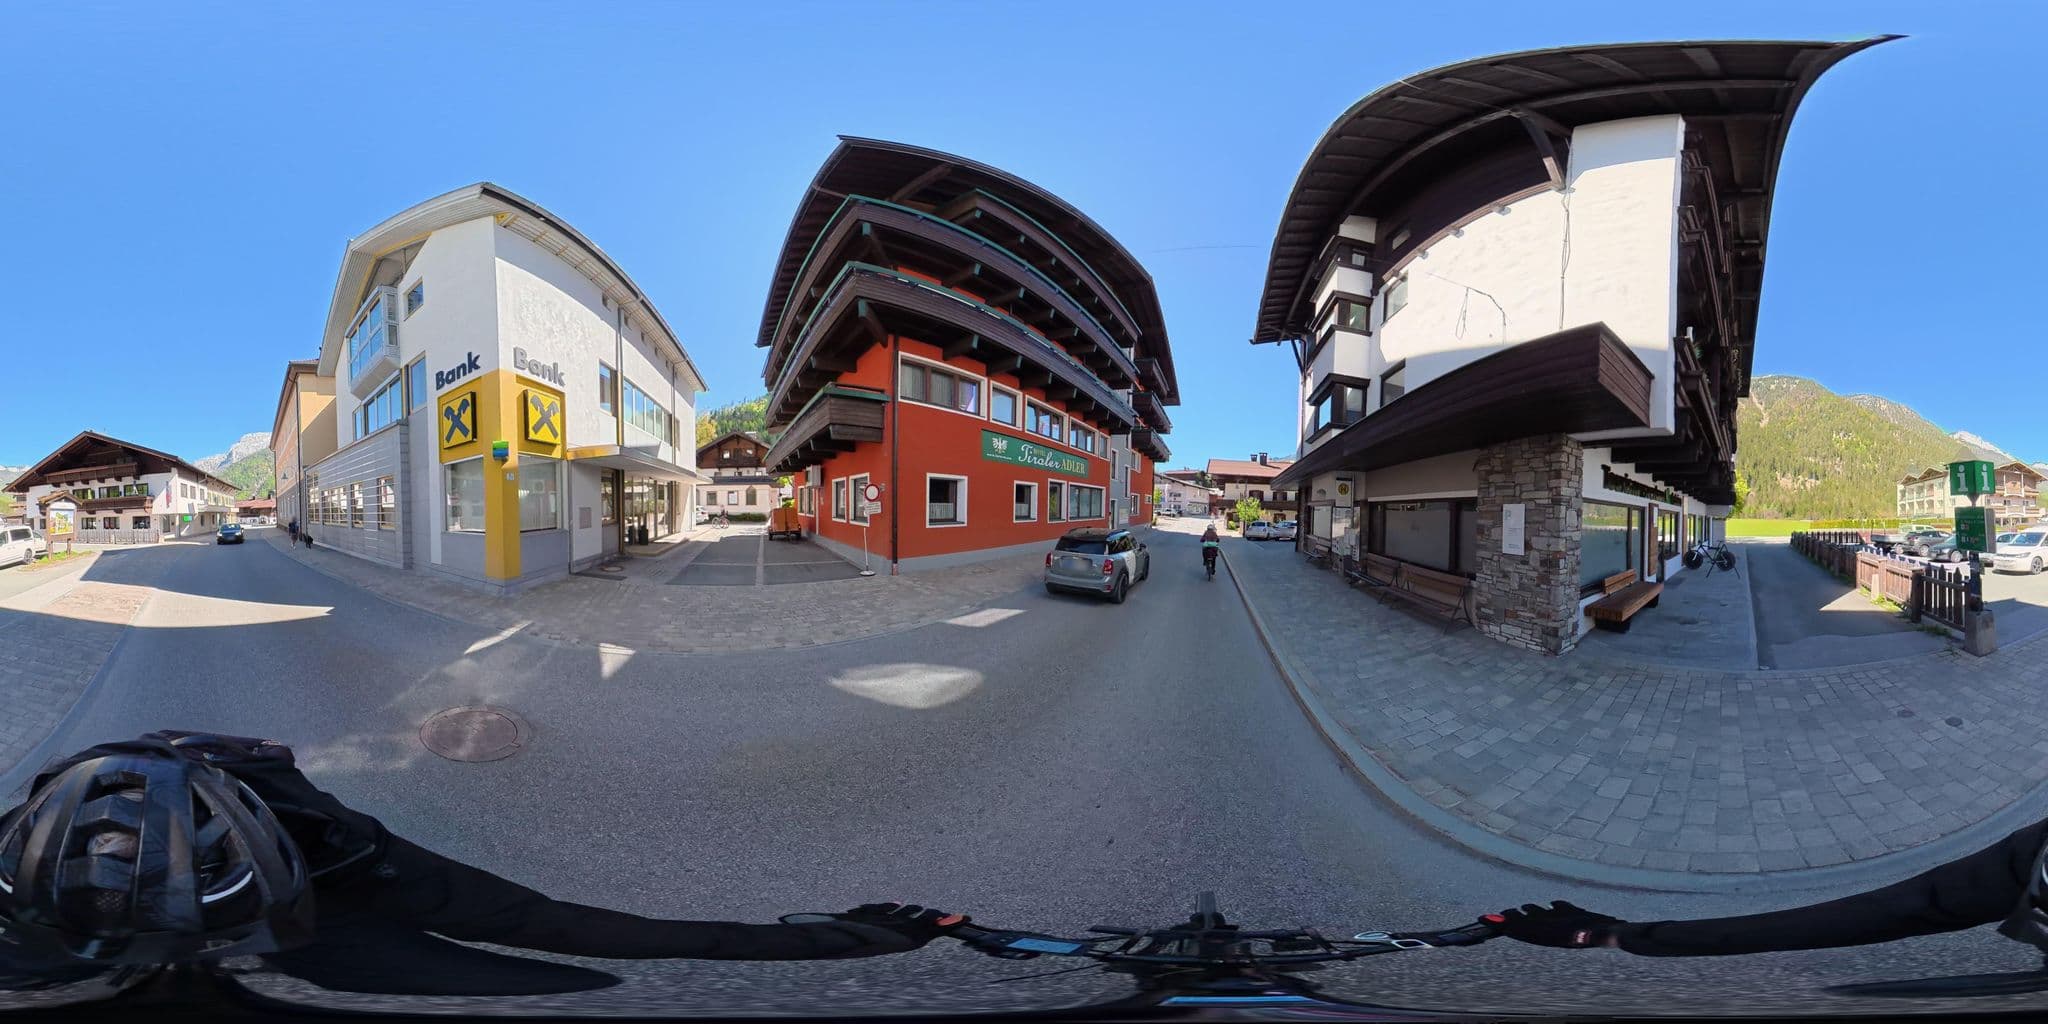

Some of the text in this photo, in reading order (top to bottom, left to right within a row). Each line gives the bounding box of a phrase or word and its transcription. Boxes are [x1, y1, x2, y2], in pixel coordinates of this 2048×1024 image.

[435, 351, 481, 391] Bank
[513, 346, 566, 387] Bank
[1018, 443, 1086, 474] Tiroler ADLER
